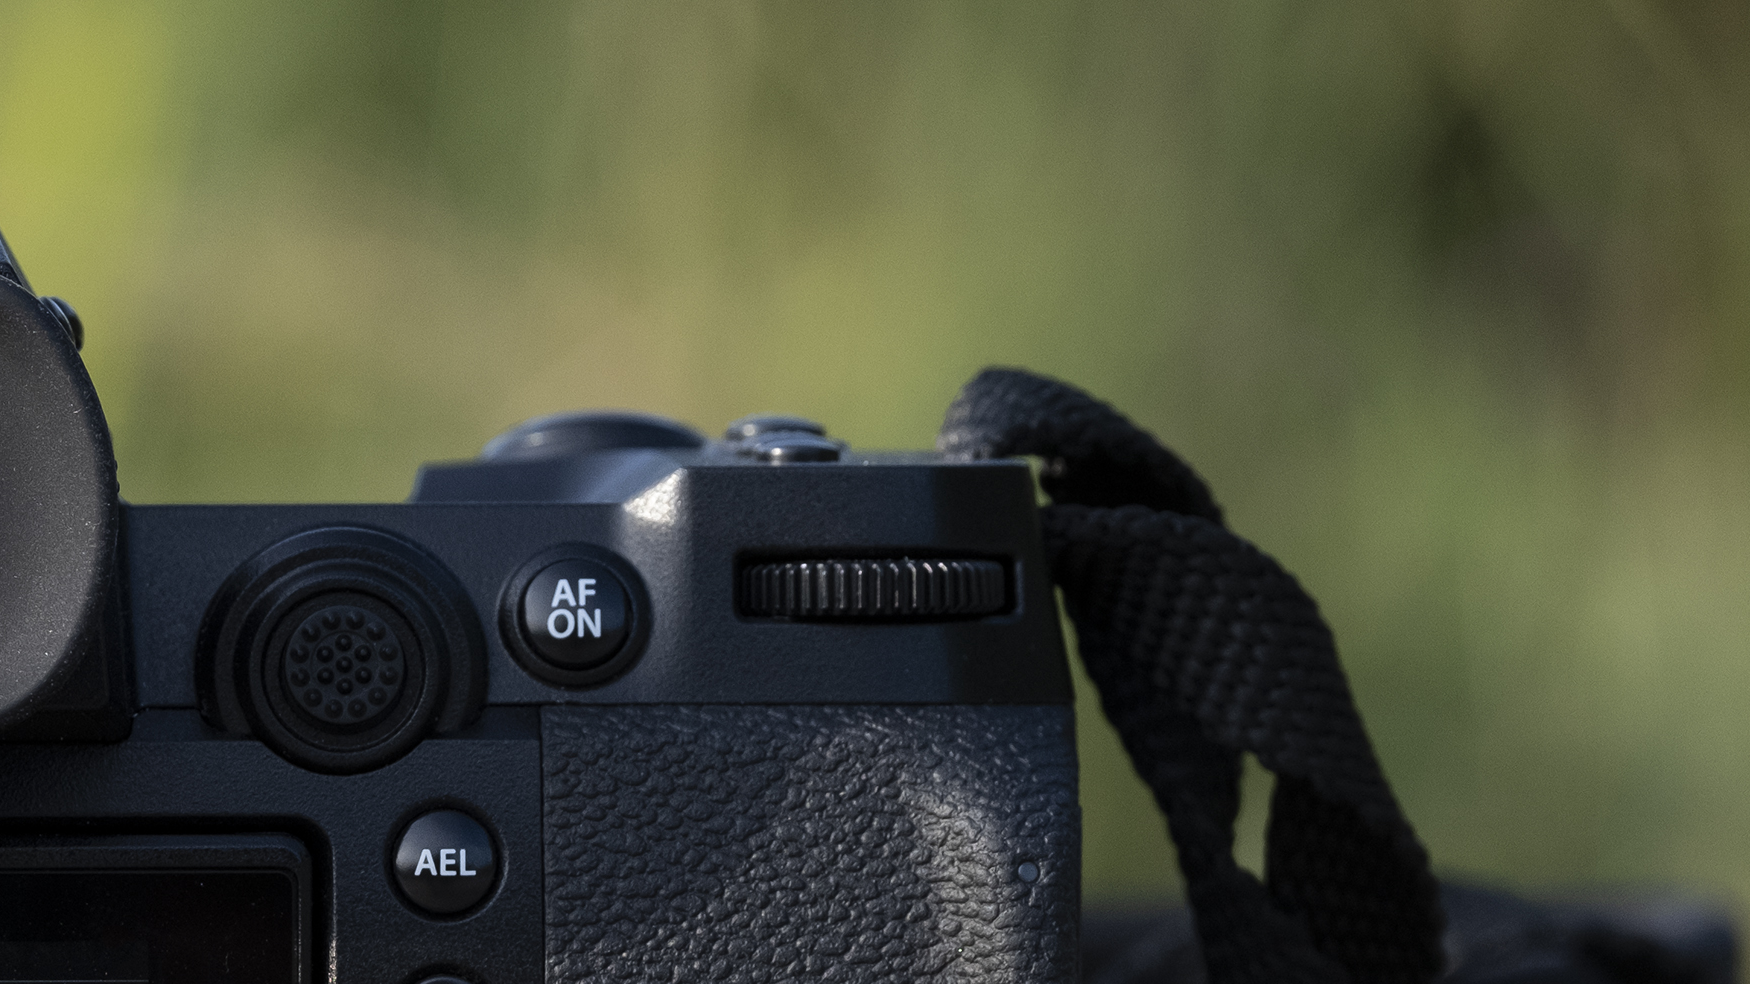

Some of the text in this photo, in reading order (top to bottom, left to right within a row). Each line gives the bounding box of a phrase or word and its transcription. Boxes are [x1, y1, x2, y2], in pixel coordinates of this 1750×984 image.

[551, 578, 597, 607] AF
[547, 608, 602, 640] ON
[414, 848, 477, 877] AEL
